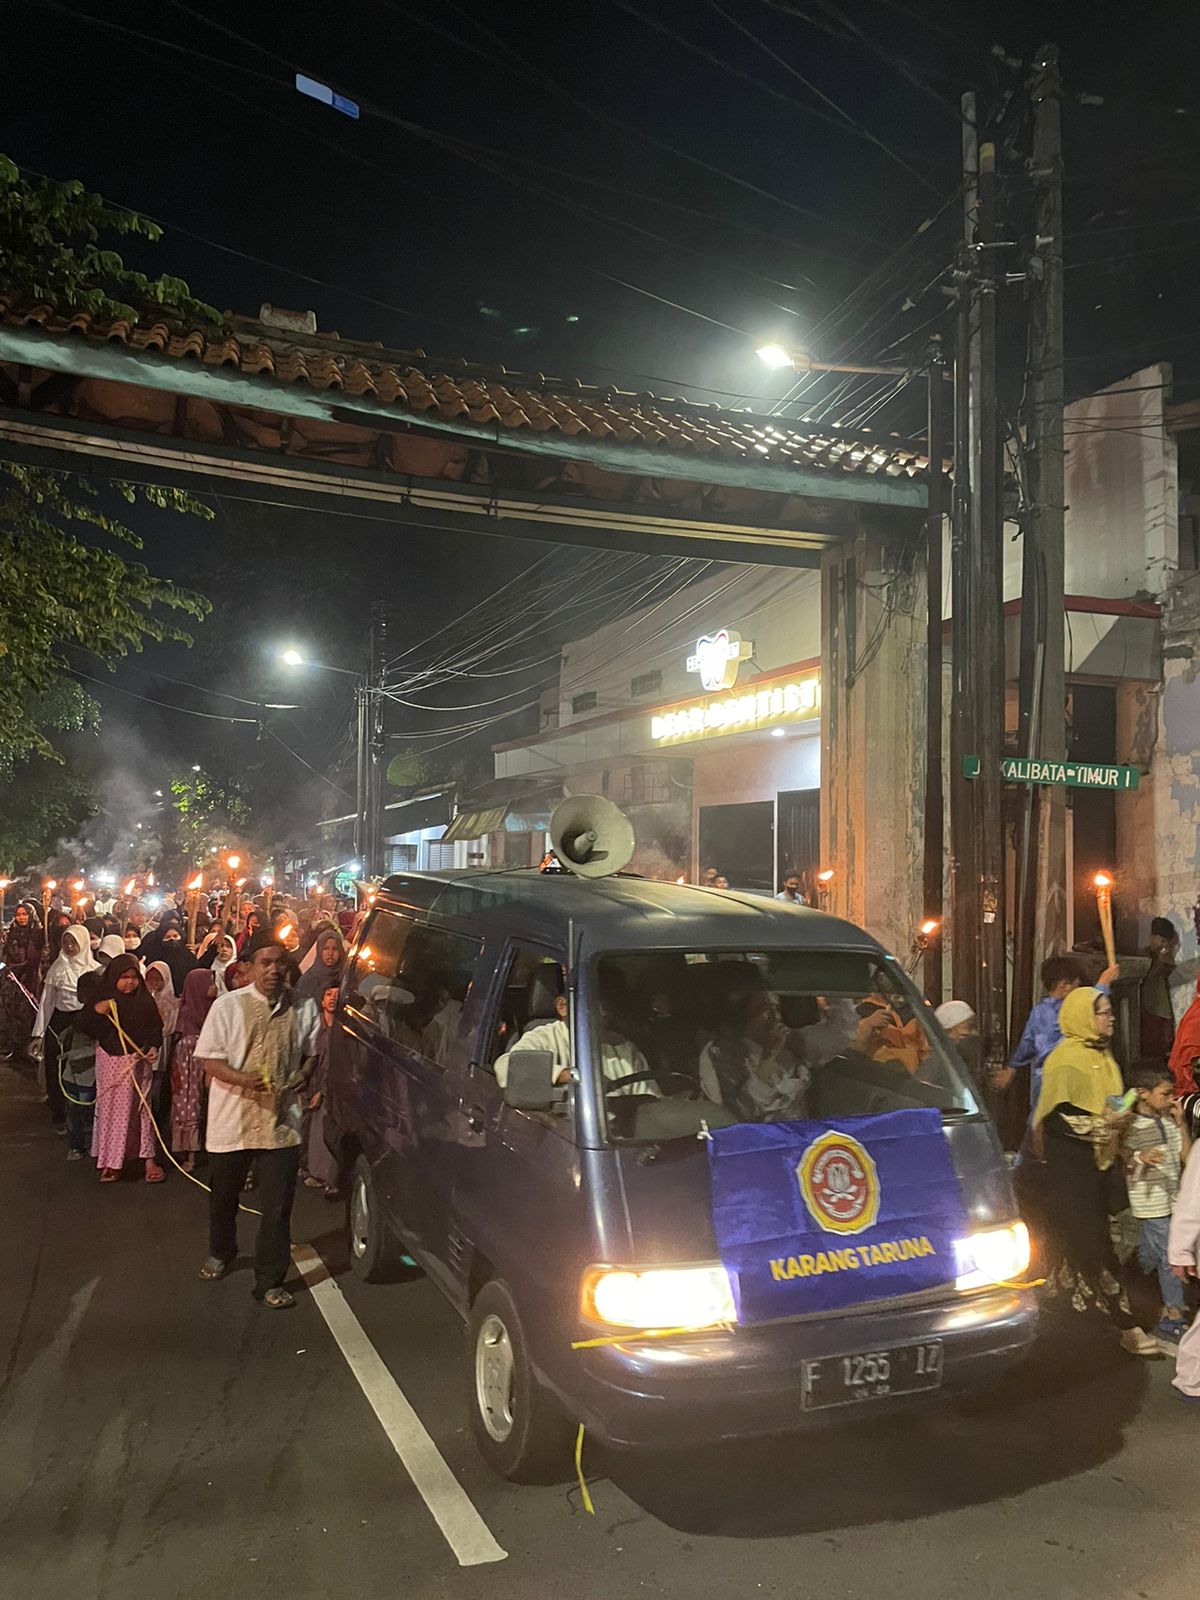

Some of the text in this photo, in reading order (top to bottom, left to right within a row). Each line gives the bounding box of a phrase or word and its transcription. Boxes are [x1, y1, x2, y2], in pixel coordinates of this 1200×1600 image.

[769, 1236, 937, 1281] KARANG TARUNA
[807, 1363, 821, 1392] F
[843, 1353, 891, 1386] 1255
